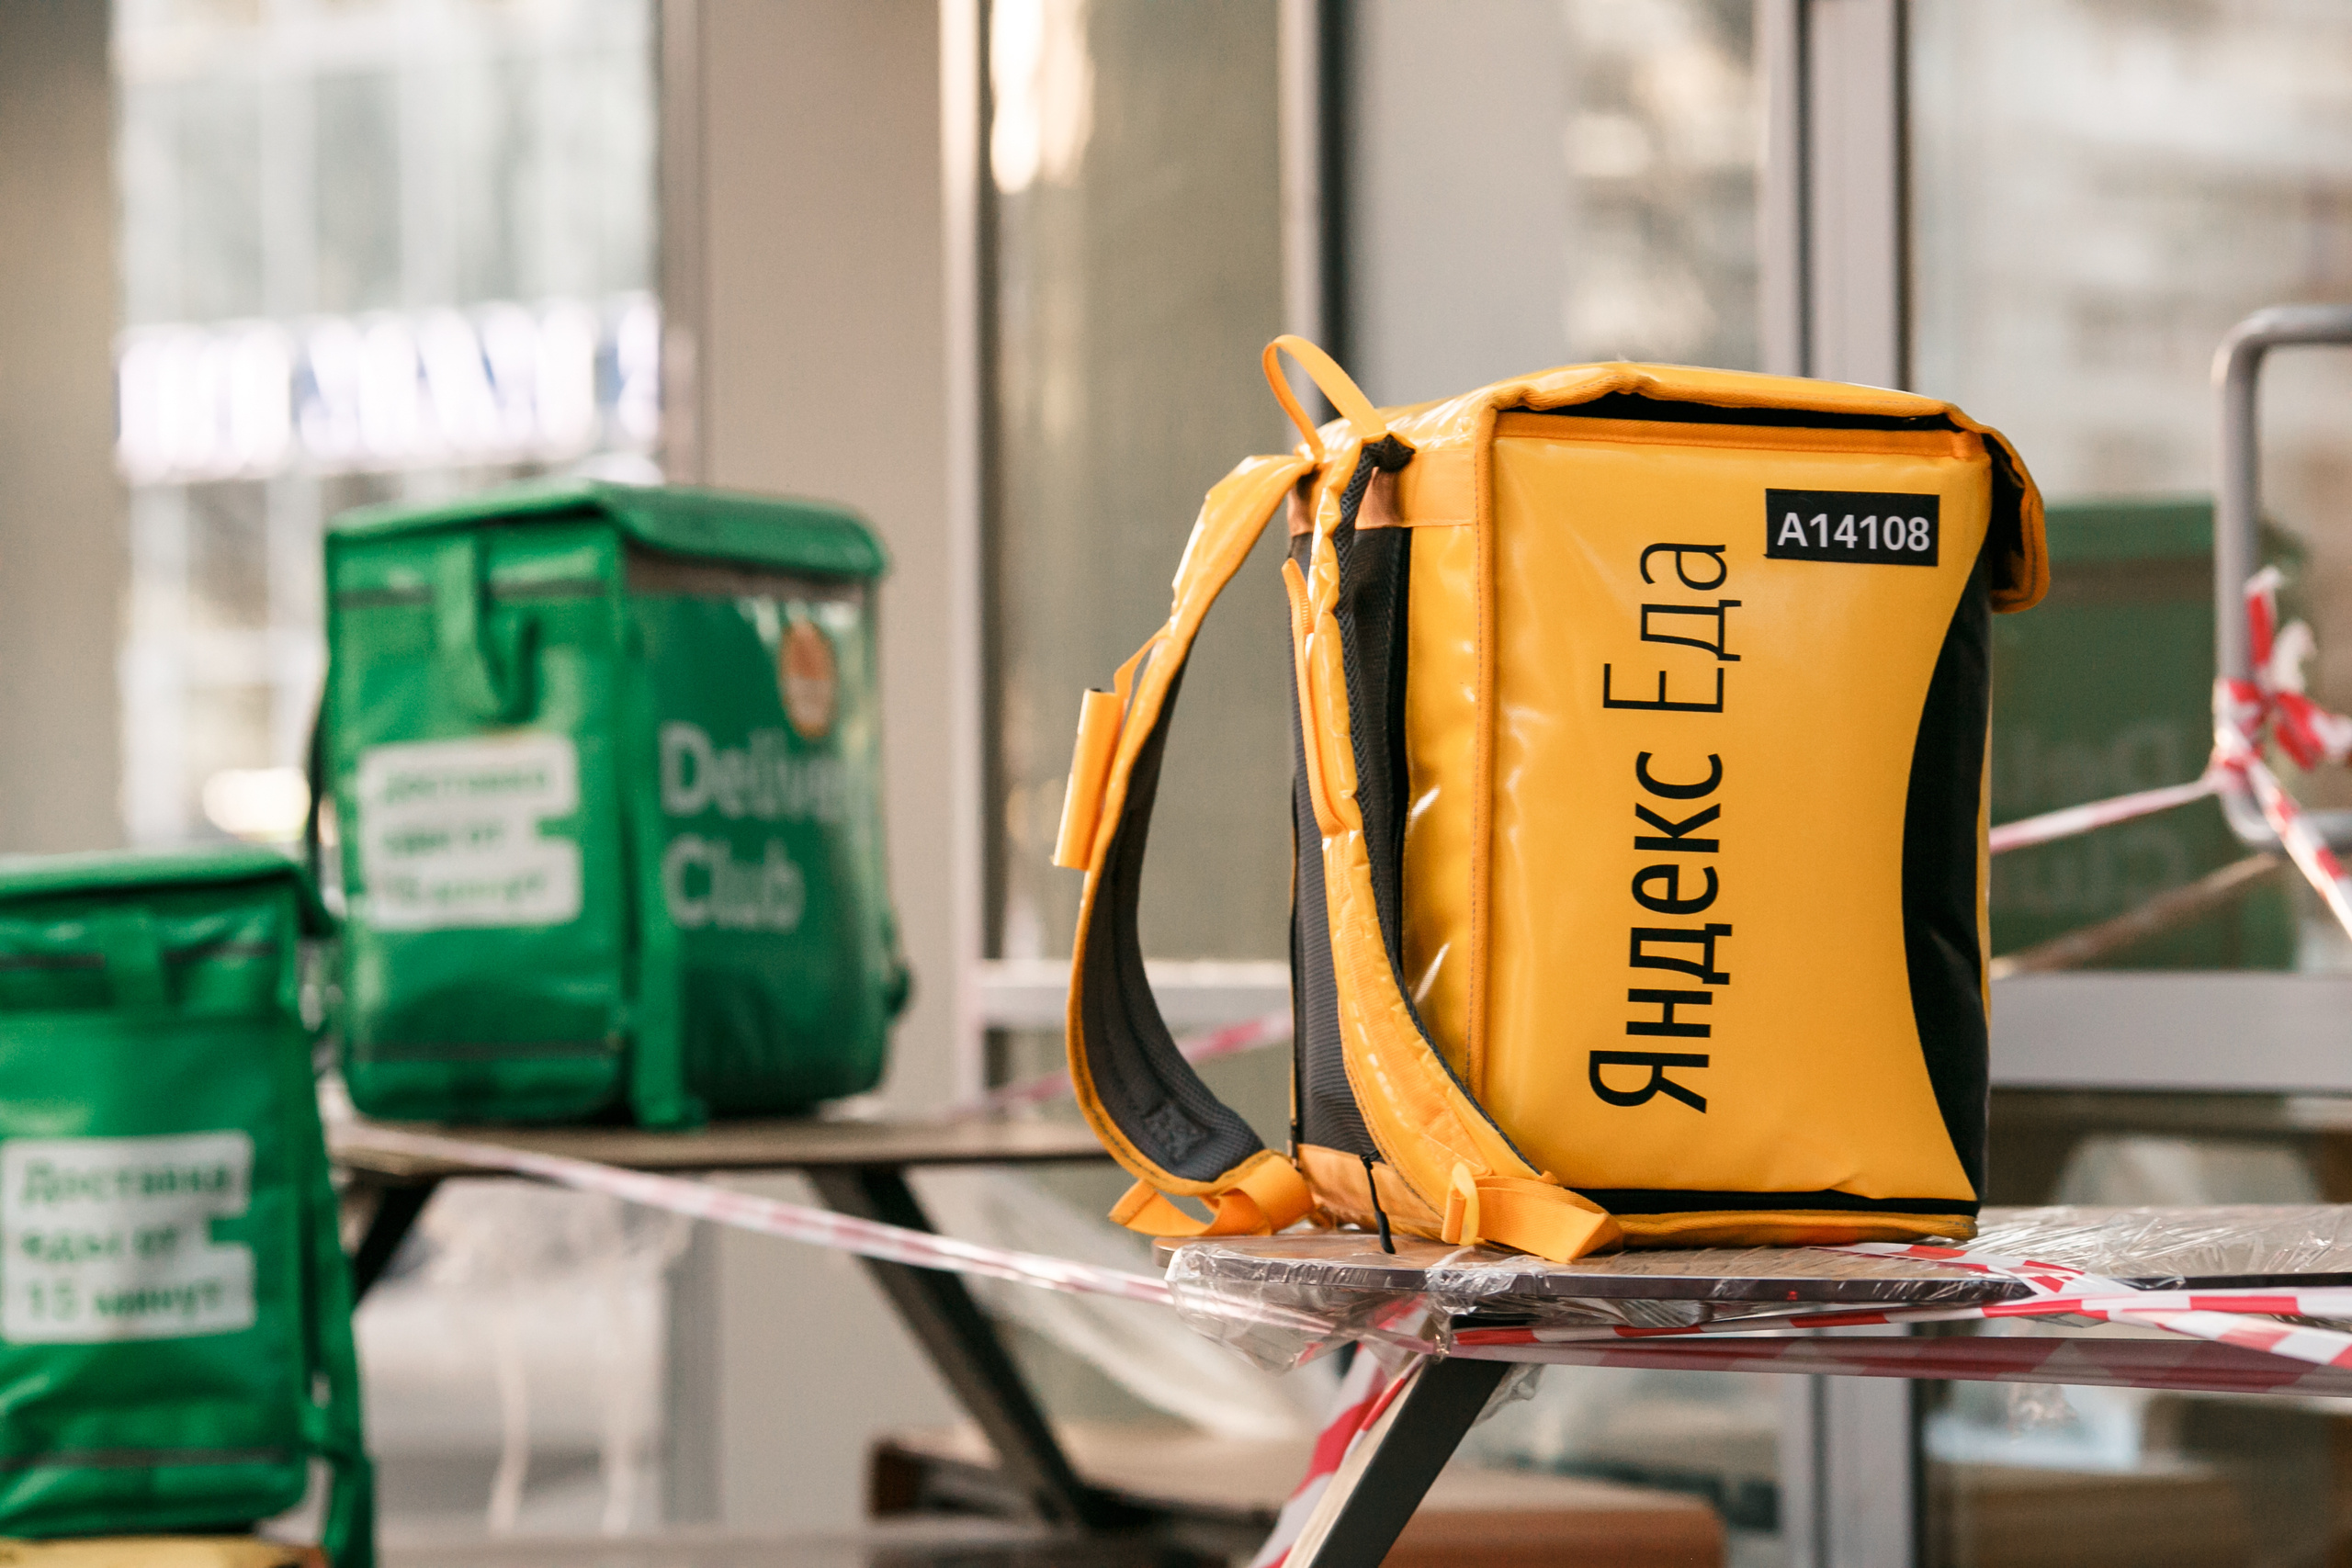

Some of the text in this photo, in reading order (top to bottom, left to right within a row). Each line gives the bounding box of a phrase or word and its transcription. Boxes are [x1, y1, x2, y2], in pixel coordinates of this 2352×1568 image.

[1777, 511, 1930, 553] A14108
[1588, 542, 1742, 1114] Яндекс Еда
[661, 835, 807, 931] Club
